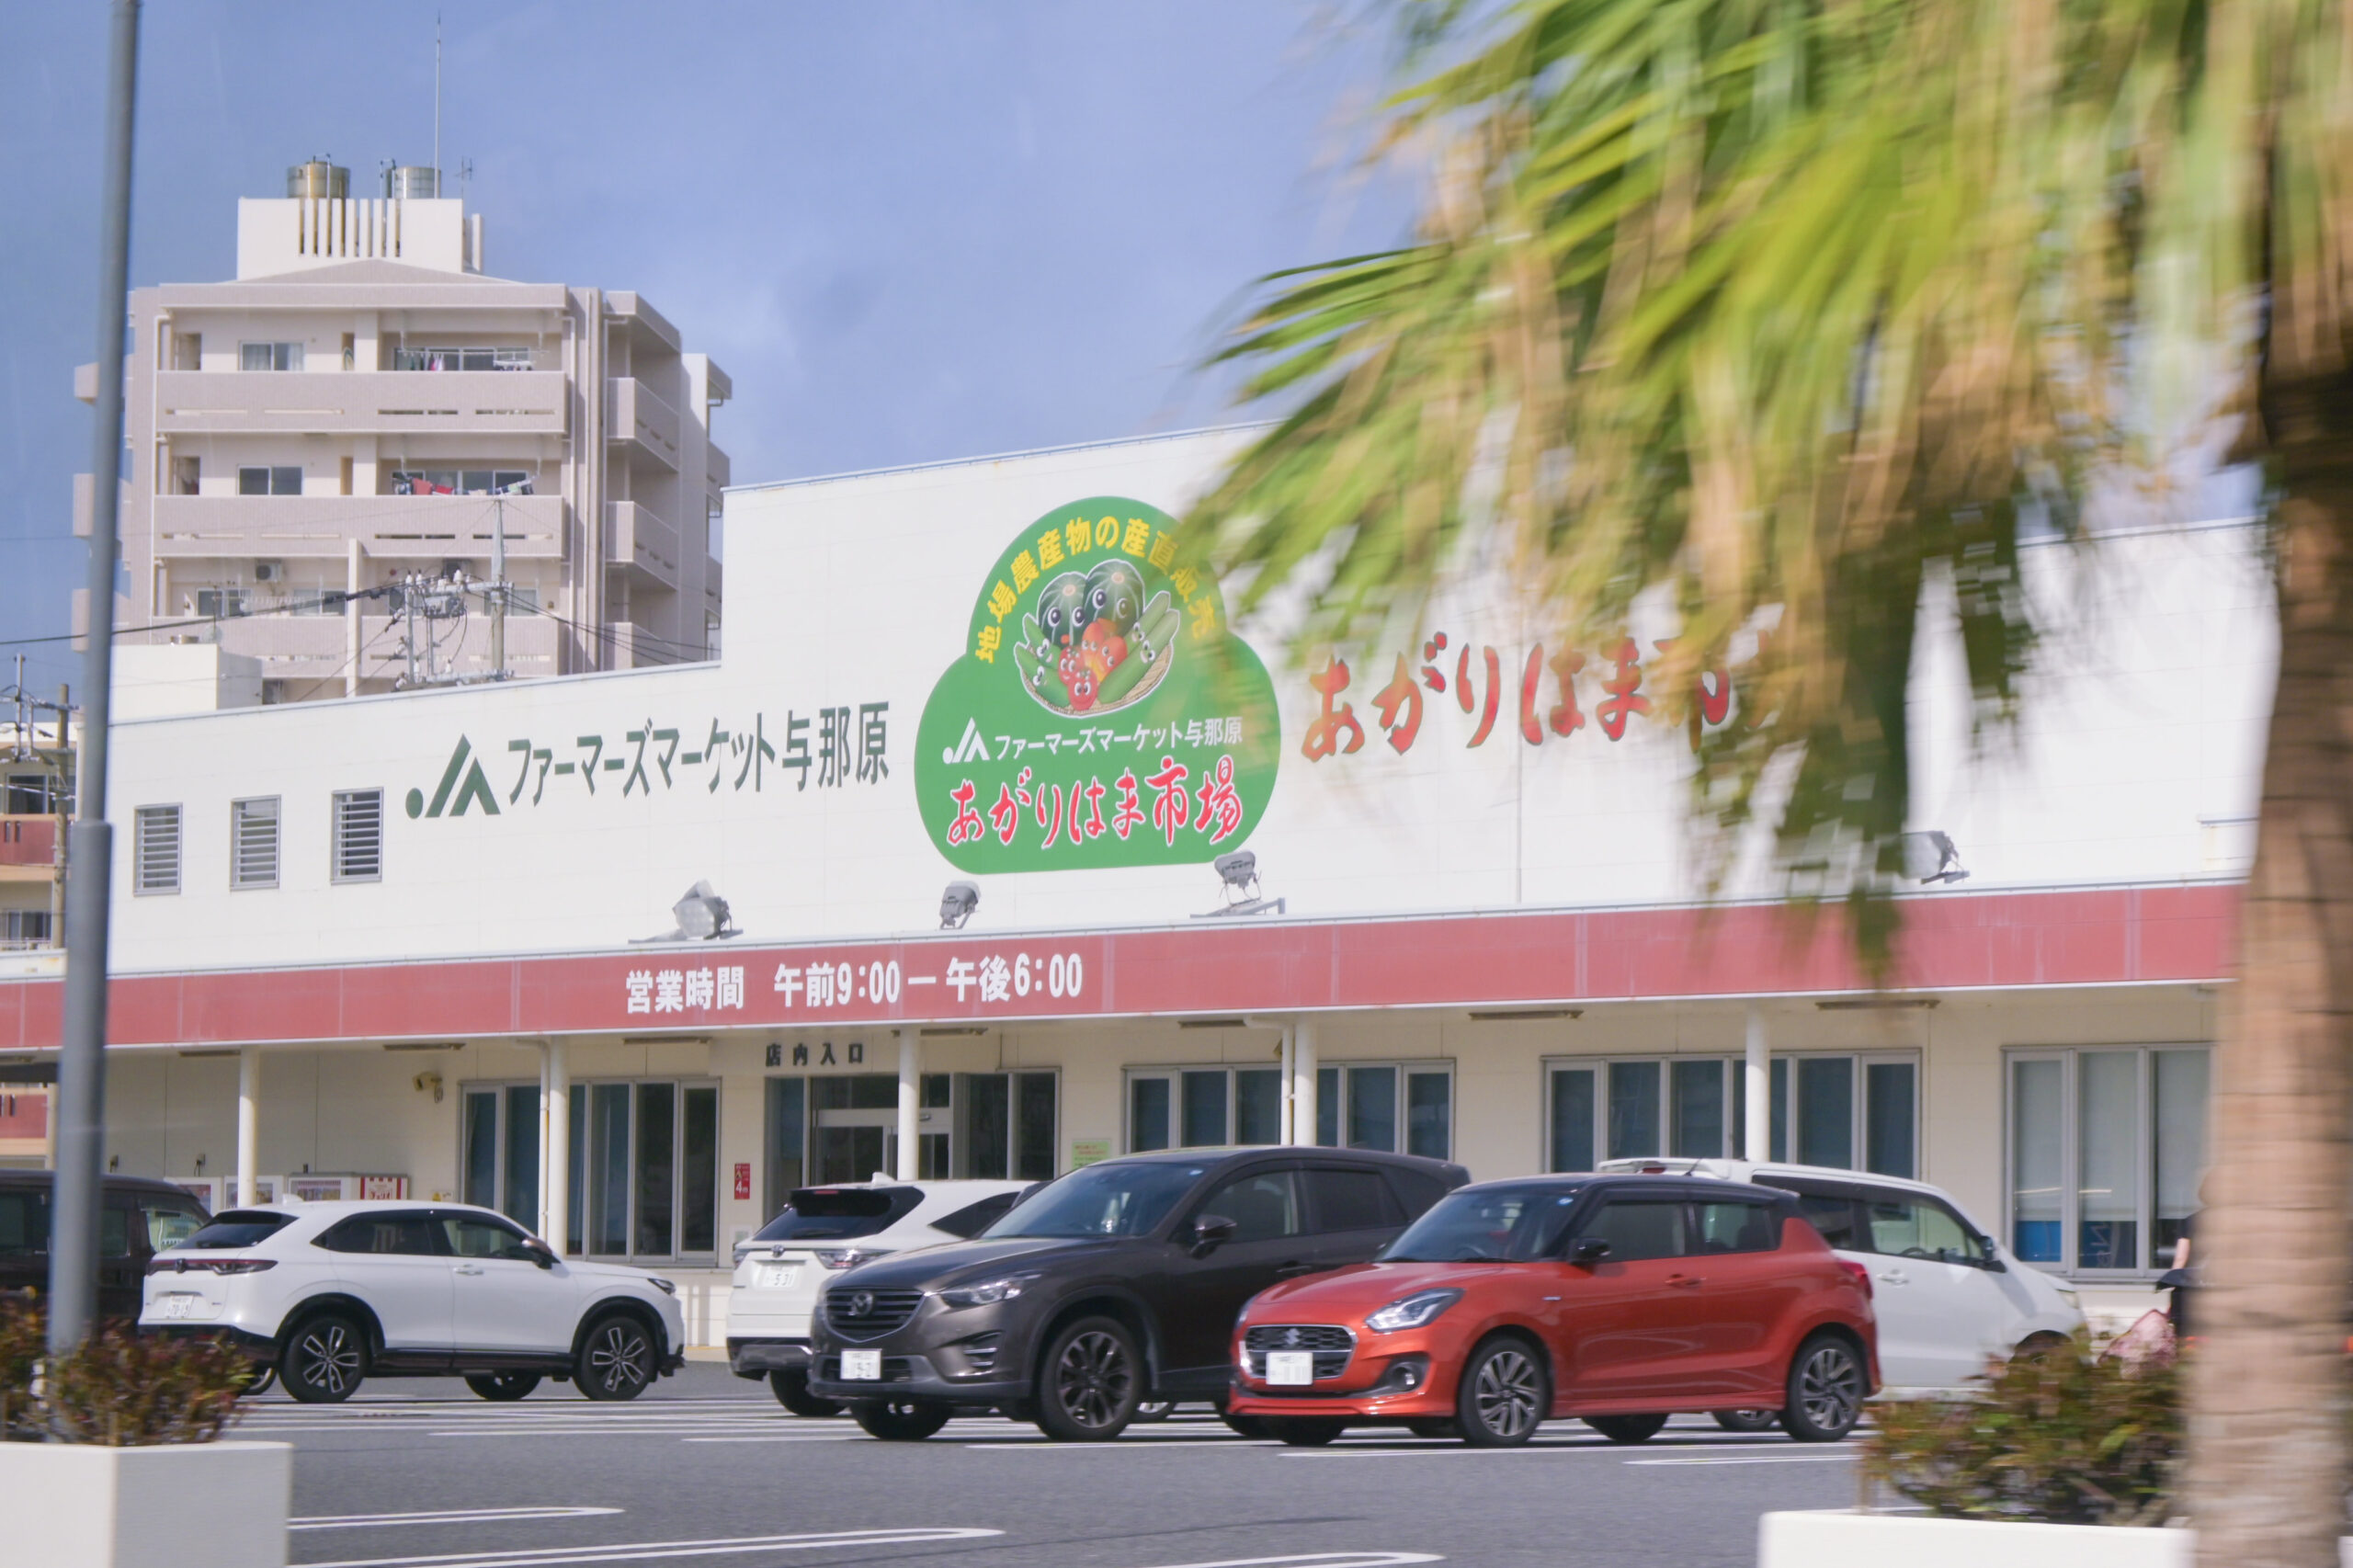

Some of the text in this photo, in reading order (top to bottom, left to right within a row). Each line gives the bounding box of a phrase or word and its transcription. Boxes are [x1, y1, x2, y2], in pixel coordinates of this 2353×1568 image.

[508, 701, 890, 808] ファーマーズマーケット与那原
[995, 716, 1243, 760] ファーマーズマーケット与那原
[947, 755, 1243, 849] あがりはま市場
[625, 965, 745, 1014] 営業時間
[765, 1042, 863, 1067] 店内入口
